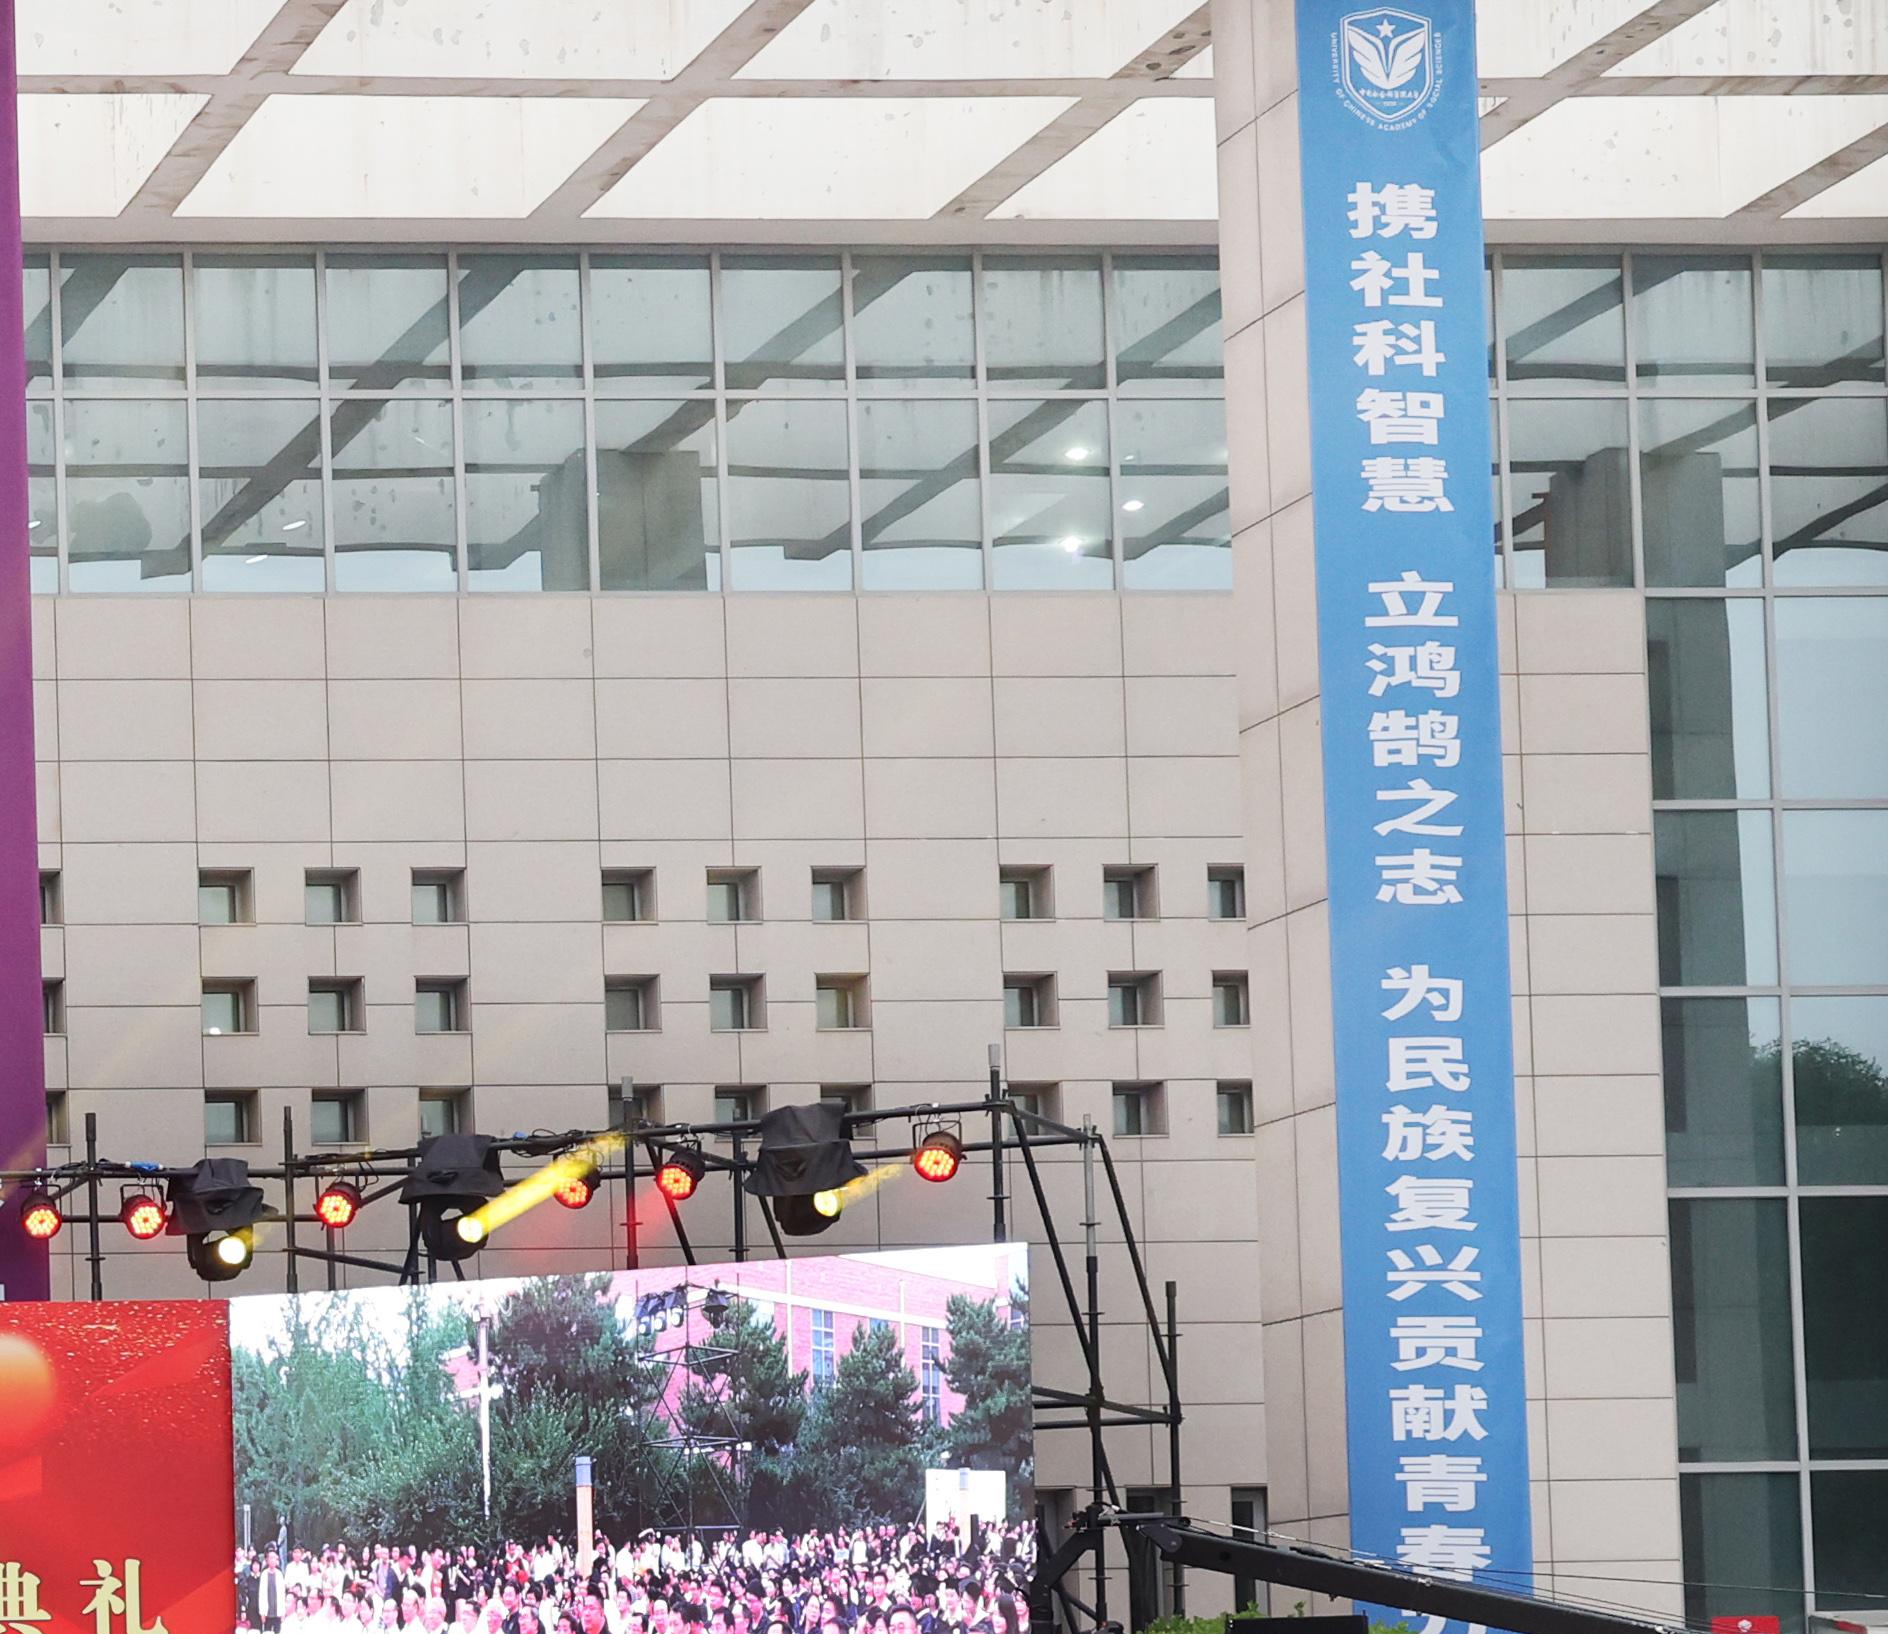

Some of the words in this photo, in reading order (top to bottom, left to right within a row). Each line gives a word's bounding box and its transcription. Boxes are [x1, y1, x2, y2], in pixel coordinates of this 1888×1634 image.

[1347, 182, 1455, 513] 携社科智慧
[1365, 571, 1464, 905] 立鸿鹄之志
